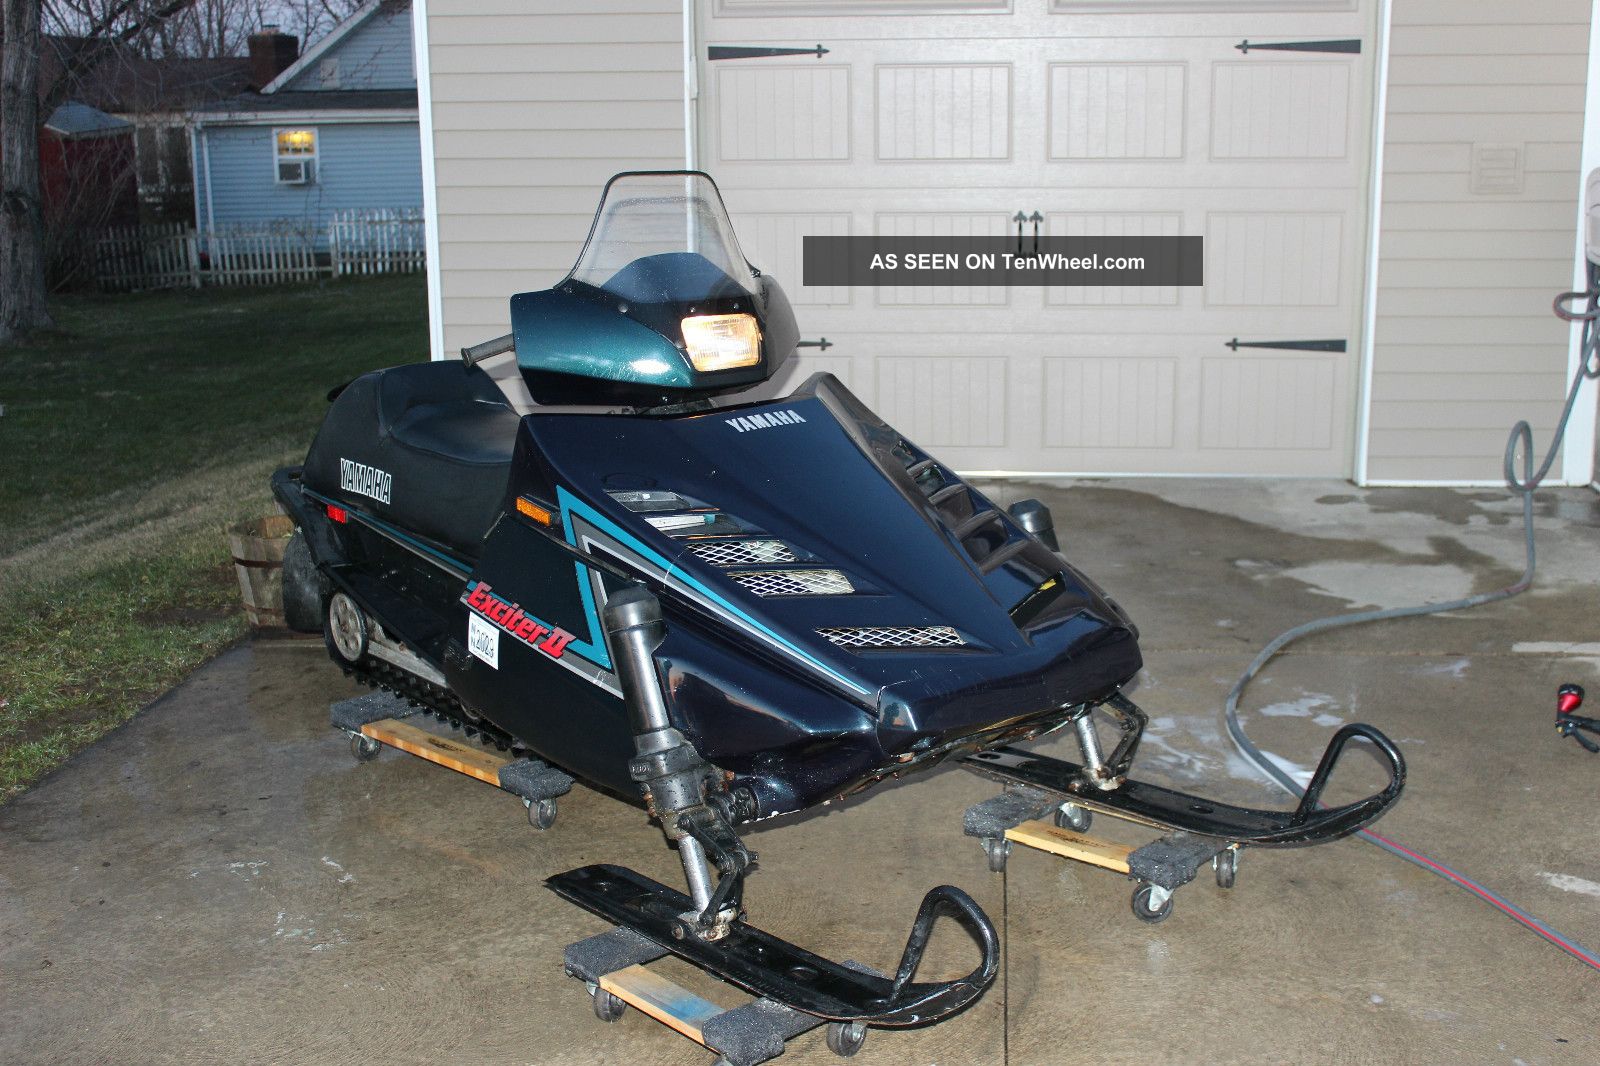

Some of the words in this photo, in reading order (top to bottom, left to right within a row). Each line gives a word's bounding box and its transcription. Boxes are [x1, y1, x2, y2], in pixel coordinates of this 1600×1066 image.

[725, 409, 807, 433] YAMAHA
[340, 457, 392, 505] YAMAHA
[466, 581, 550, 645] Exciter
